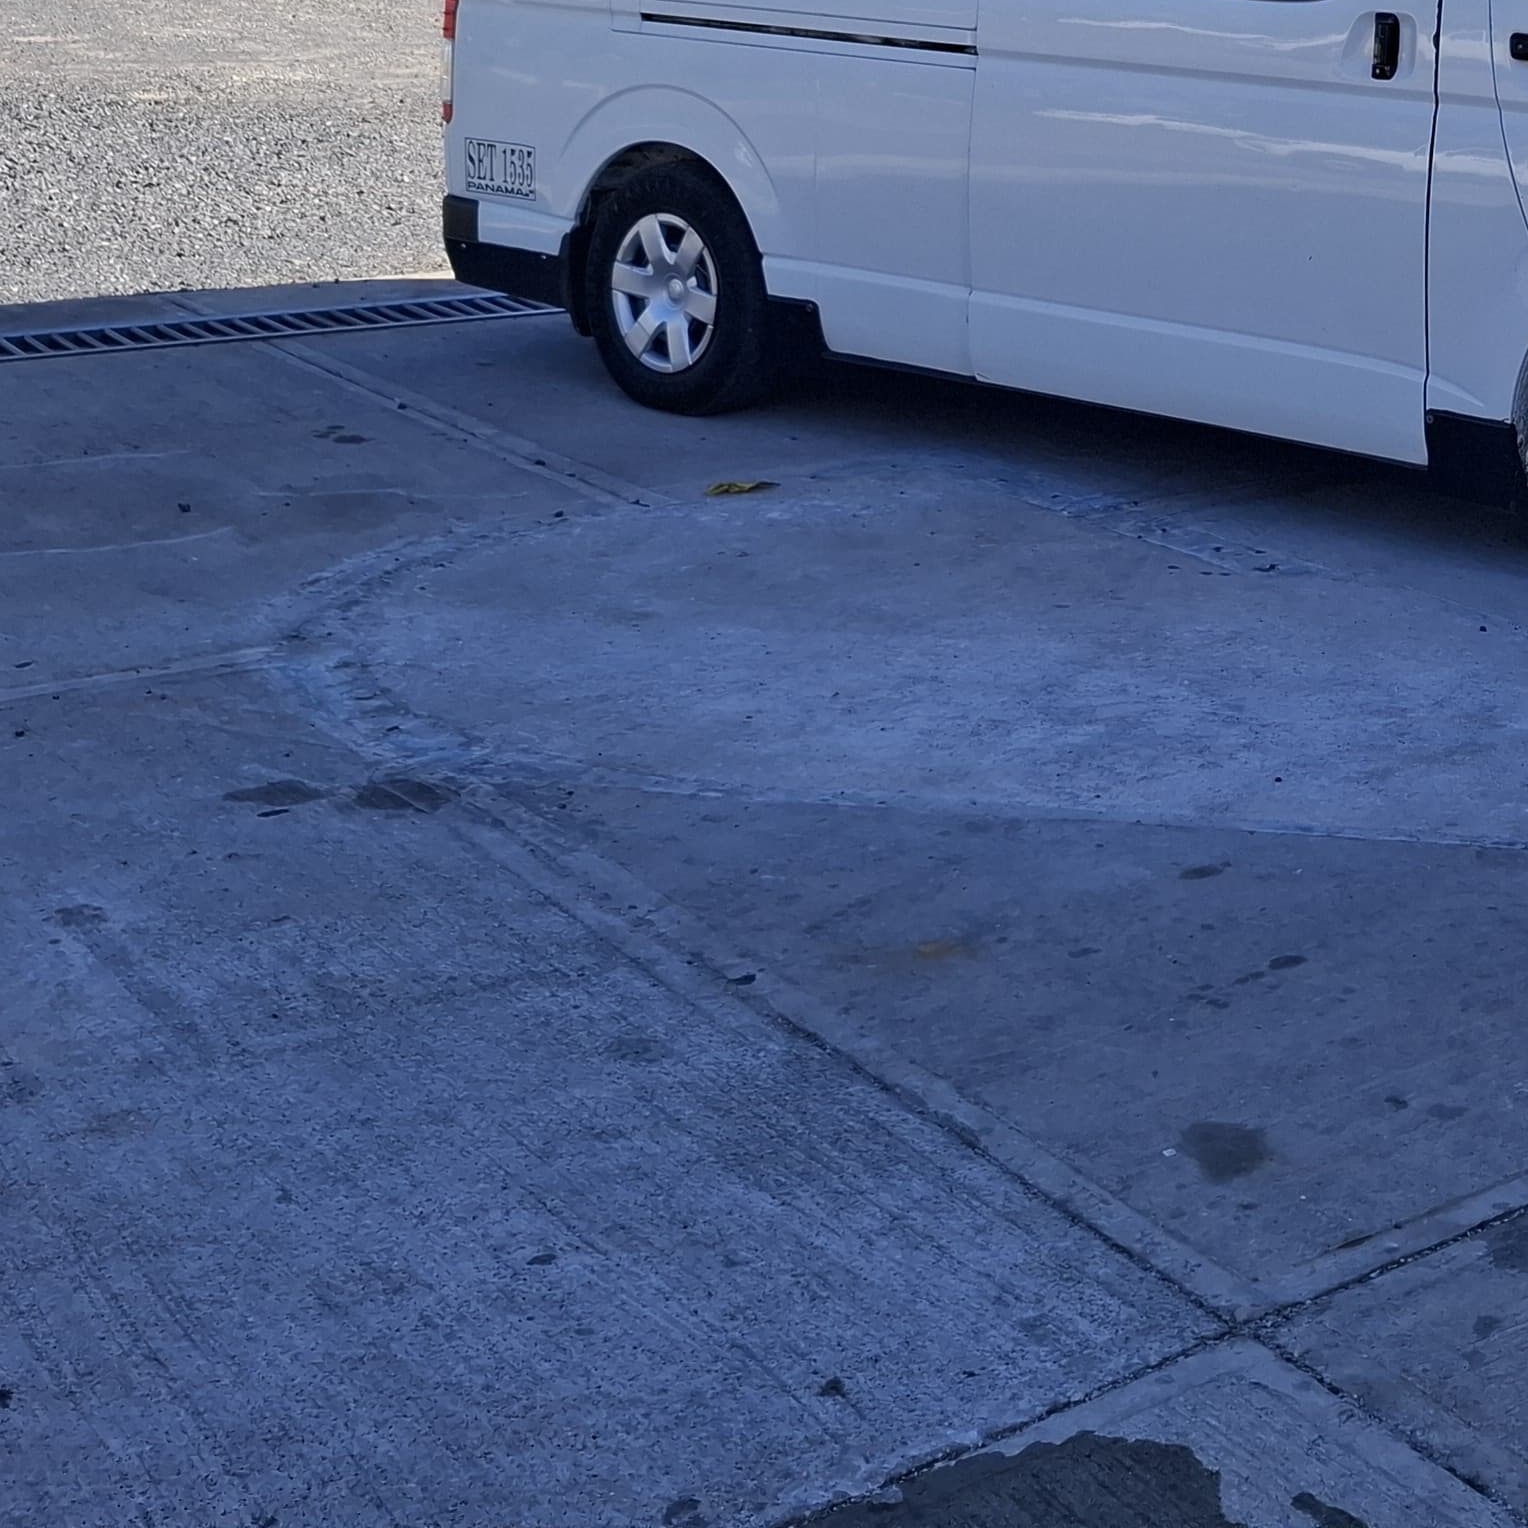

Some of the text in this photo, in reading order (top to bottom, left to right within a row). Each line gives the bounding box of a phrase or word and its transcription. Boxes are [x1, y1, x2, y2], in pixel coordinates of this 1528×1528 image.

[467, 140, 533, 187] SET 1535
[467, 180, 524, 197] PANAMA
